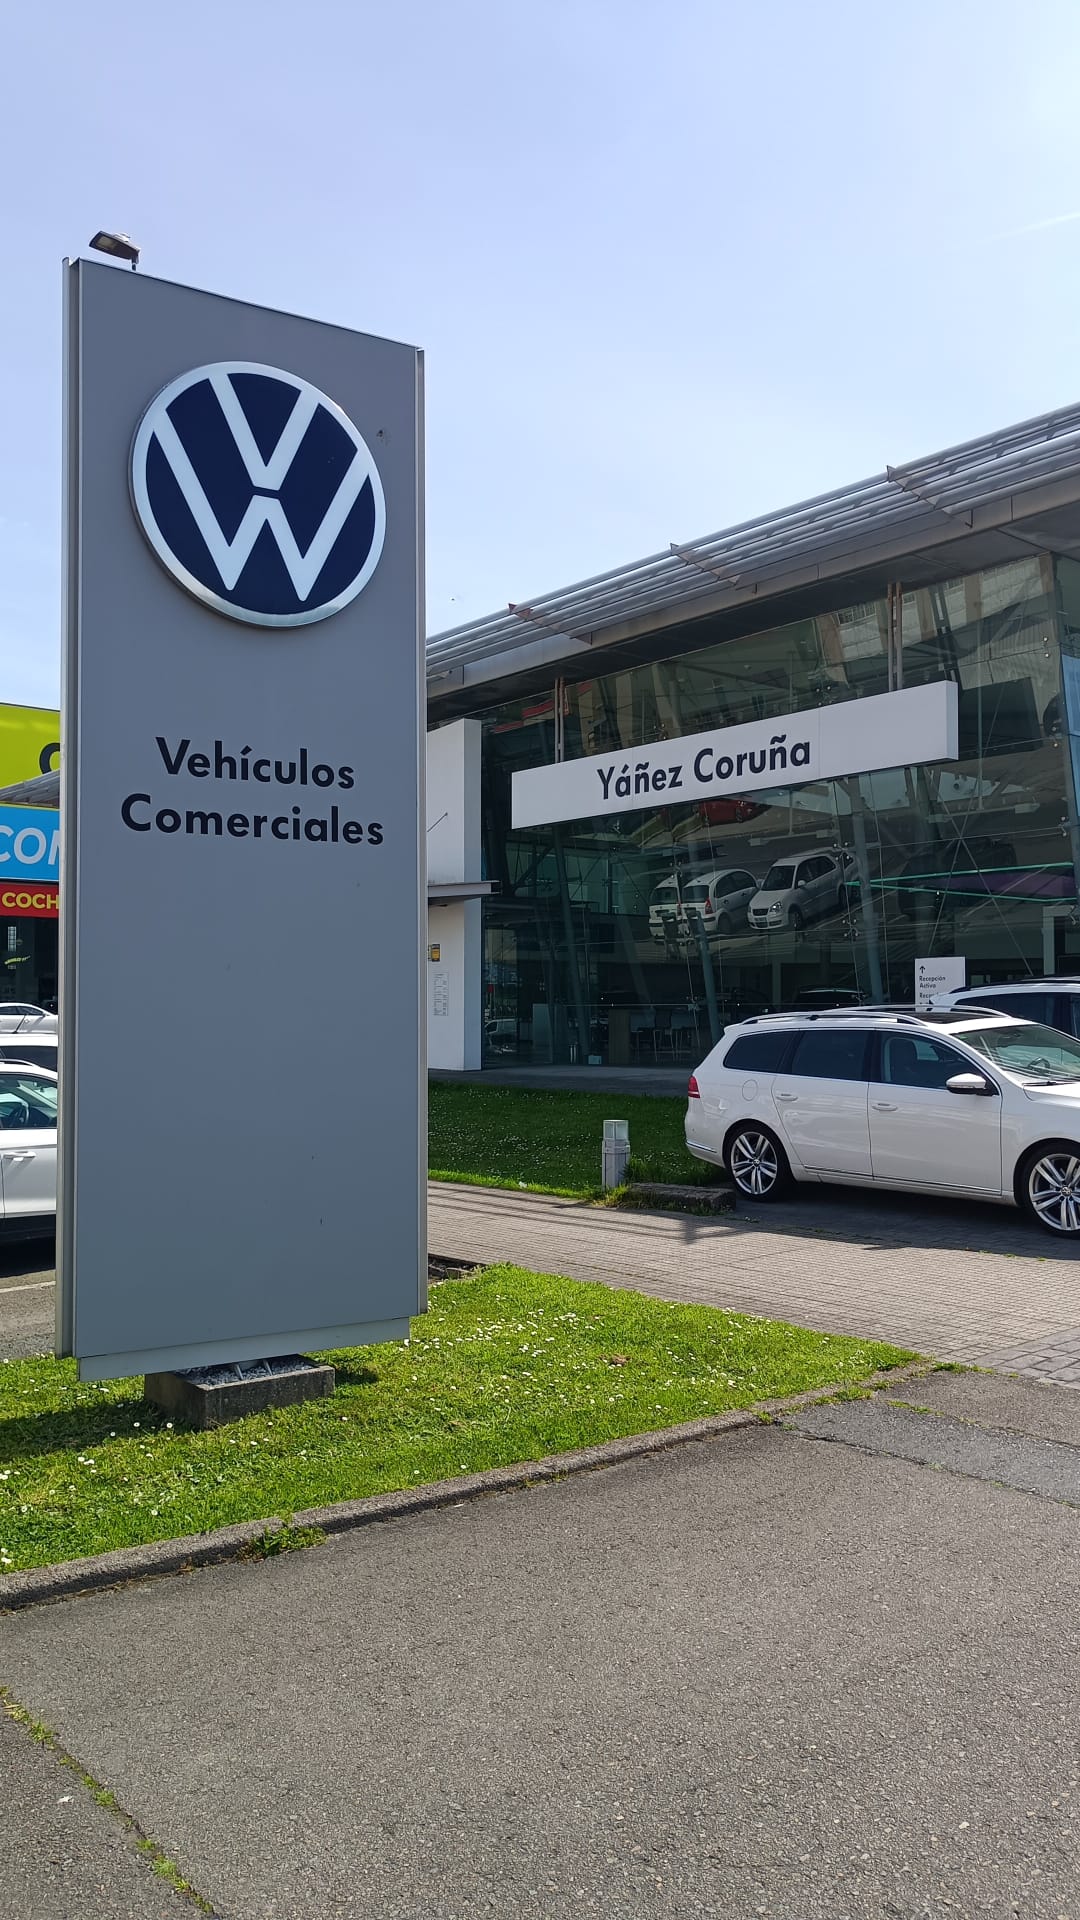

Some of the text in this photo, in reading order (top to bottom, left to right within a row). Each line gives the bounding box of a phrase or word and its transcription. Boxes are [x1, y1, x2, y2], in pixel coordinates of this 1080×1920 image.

[155, 736, 355, 789] Vehículos
[597, 734, 811, 800] Yáñez Coruña
[121, 792, 384, 845] Comerciales
